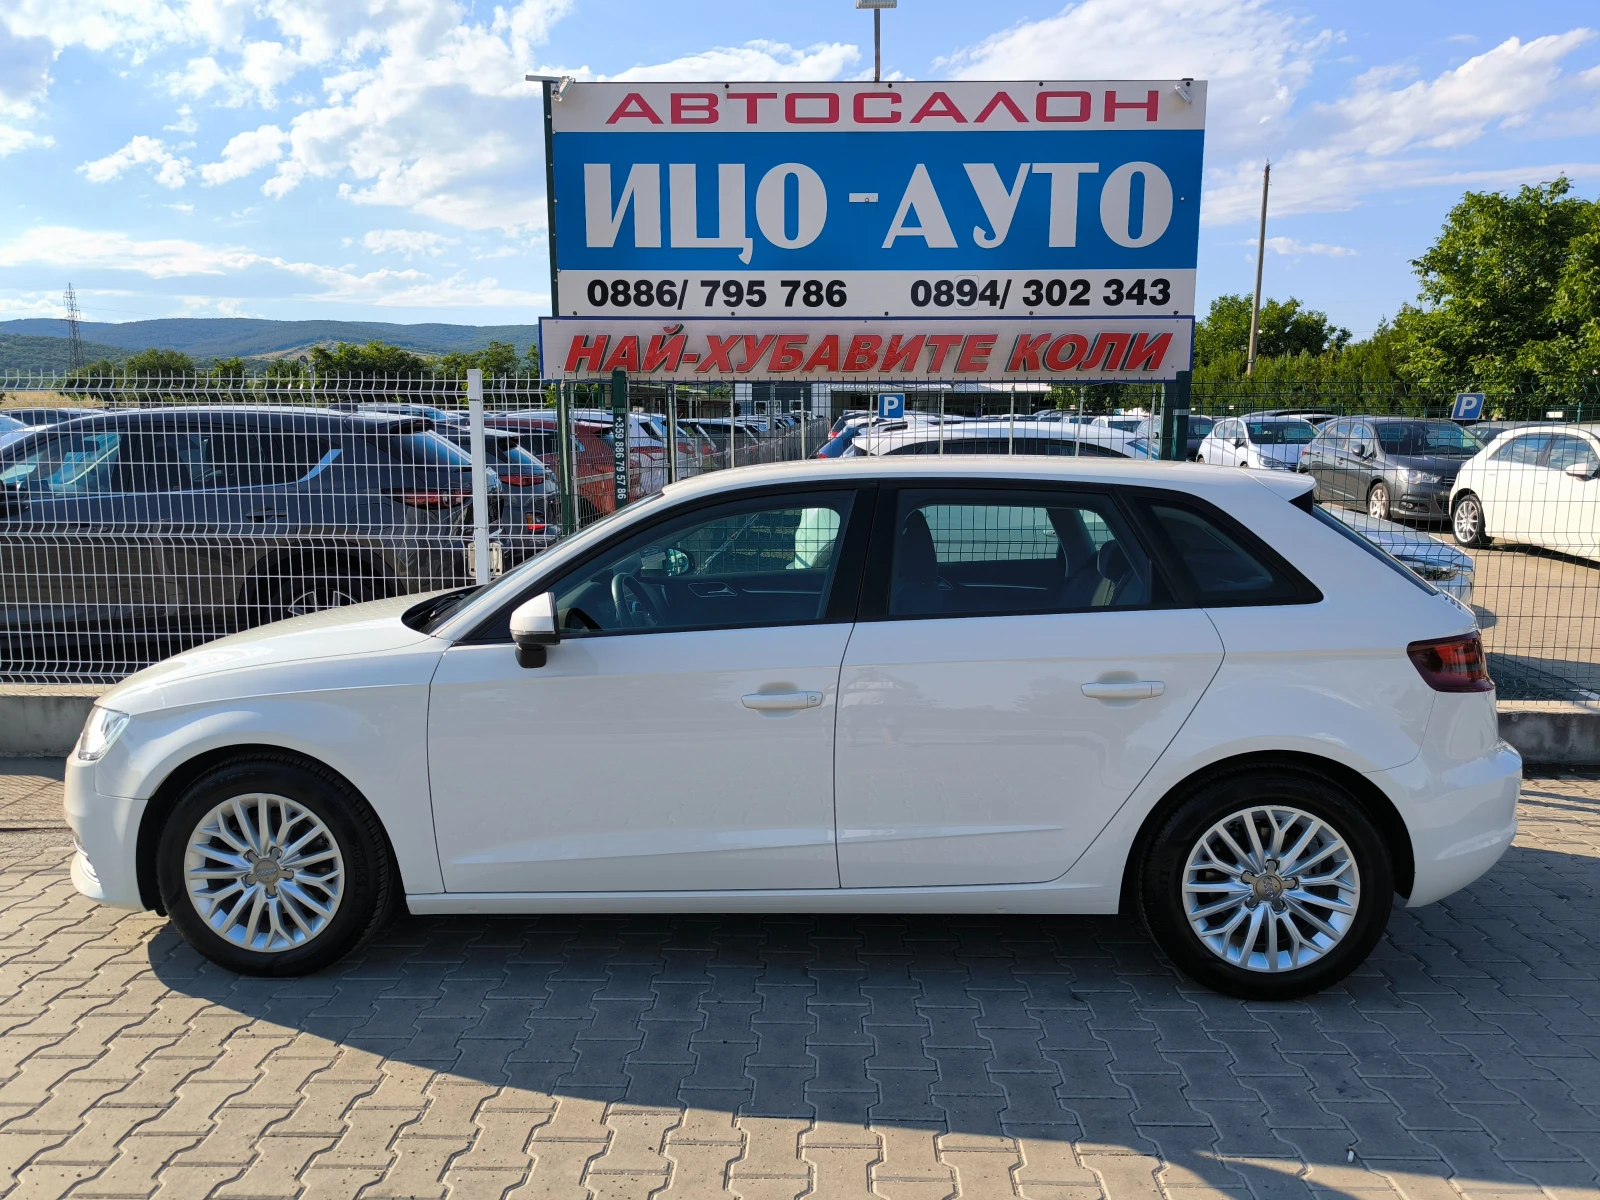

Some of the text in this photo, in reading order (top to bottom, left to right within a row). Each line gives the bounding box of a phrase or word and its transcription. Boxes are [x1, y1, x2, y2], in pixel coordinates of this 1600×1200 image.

[605, 90, 1159, 125] АВТОСАЛОН
[583, 162, 828, 265] ИЦО
[586, 279, 848, 310] 0886/ 795 786
[910, 277, 1171, 310] 0894/ 302 343
[563, 323, 1173, 373] НАЙ-ХУБАВИТЕ КОЛИ
[883, 396, 899, 416] P
[1458, 396, 1478, 417] P
[614, 416, 627, 500] +359 886 79 57 86
